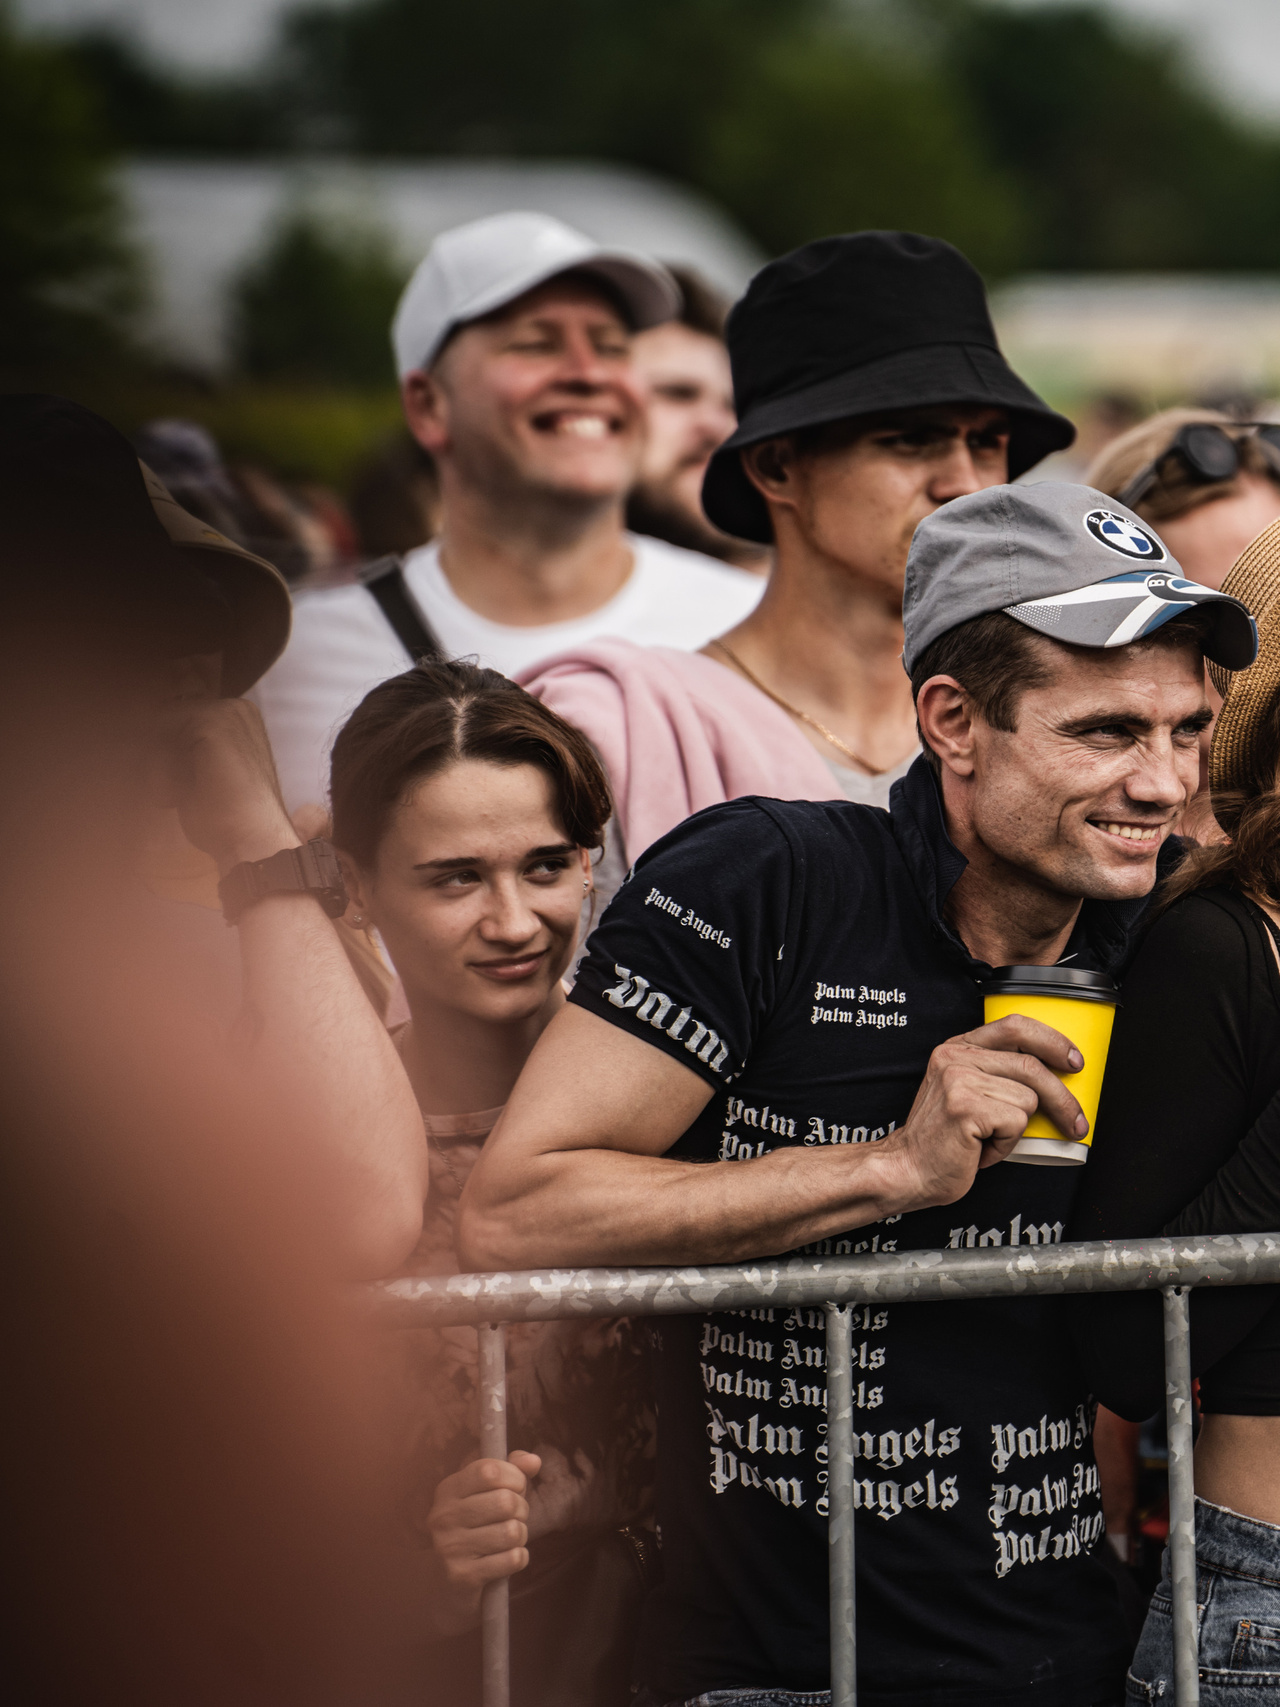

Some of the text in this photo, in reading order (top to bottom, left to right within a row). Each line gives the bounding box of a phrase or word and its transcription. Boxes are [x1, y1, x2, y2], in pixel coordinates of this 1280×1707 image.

[645, 887, 732, 949] Palm Angels
[602, 963, 731, 1073] Palm
[810, 1005, 908, 1030] Palm Angels
[814, 982, 907, 1006] Palm Angels
[725, 1096, 797, 1139] Palm
[718, 1131, 772, 1162] Pal
[783, 1305, 888, 1332] Anels
[700, 1322, 774, 1363] Palm
[781, 1339, 886, 1371] Anls
[700, 1362, 884, 1410] Palm Anls
[991, 1414, 1071, 1474] Palm
[710, 1446, 807, 1509] Pam
[988, 1474, 1068, 1529] Palm
[993, 1525, 1083, 1579] Palm
